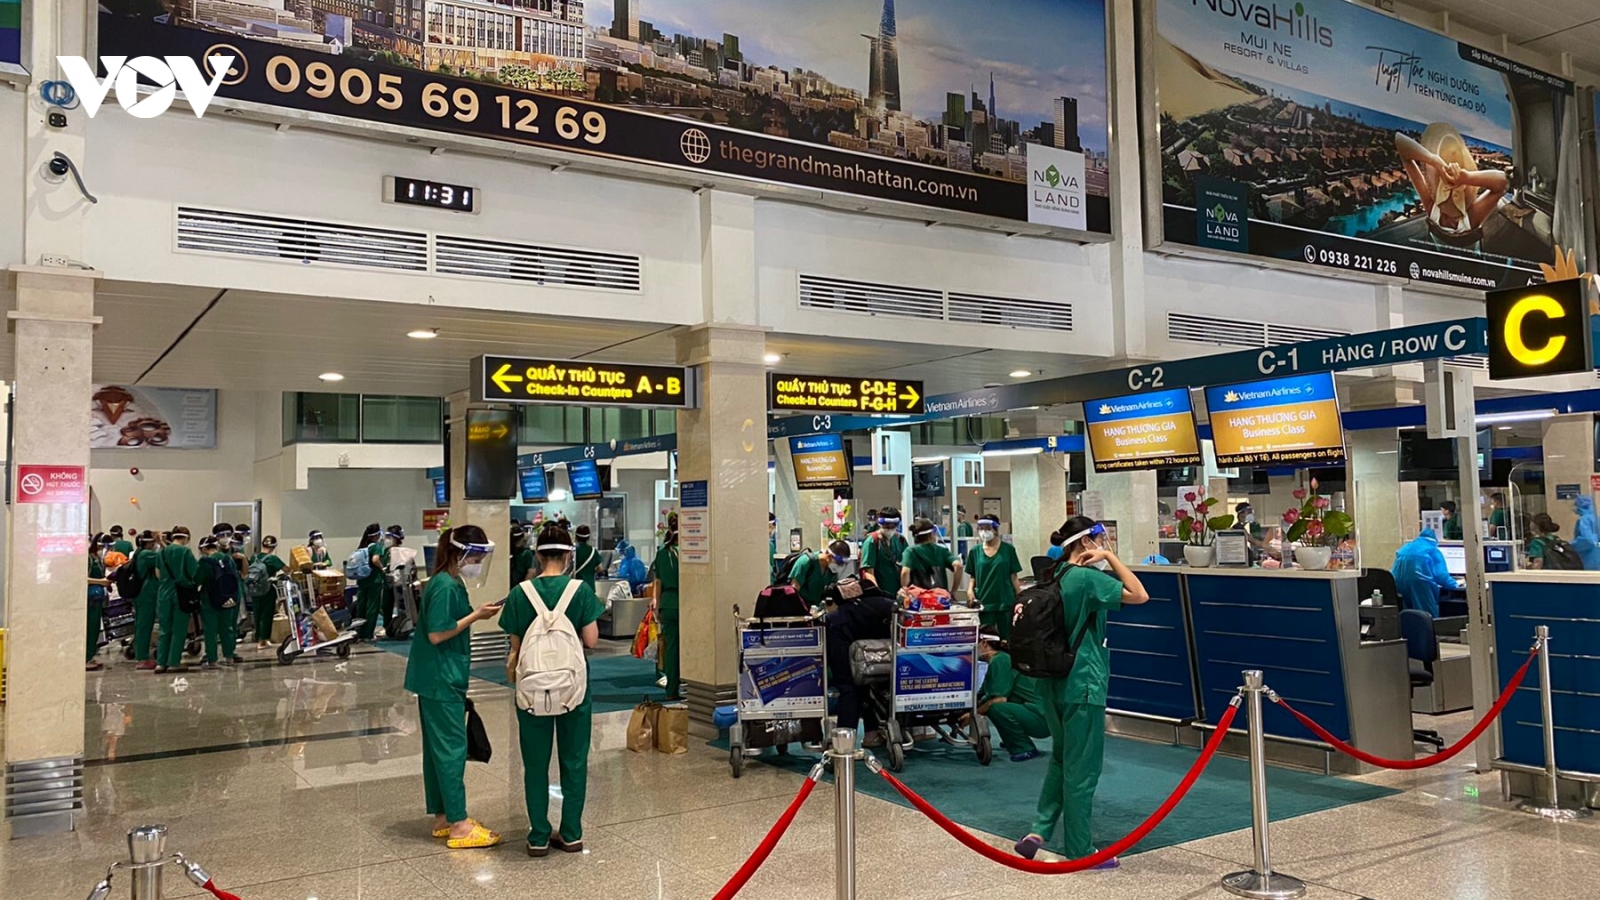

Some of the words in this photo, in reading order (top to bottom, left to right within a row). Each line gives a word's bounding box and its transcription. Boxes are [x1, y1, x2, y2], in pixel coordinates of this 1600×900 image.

[1240, 31, 1268, 50] MUI
[1273, 42, 1292, 58] NE
[1223, 42, 1263, 61] RESORT
[1266, 55, 1275, 64] &
[1277, 59, 1309, 75] VILLAS
[266, 55, 403, 111] 0905
[421, 82, 480, 123] 69
[495, 95, 540, 134] 12
[555, 107, 607, 145] 69
[1457, 96, 1474, 110] CAO
[719, 139, 979, 202] thegrandmanhattan.com.vn
[407, 181, 471, 206] 11:31
[1034, 190, 1080, 208] LAND
[1206, 224, 1239, 238] LAND
[1319, 249, 1350, 267] 0938
[1354, 255, 1373, 270] 221
[1377, 259, 1397, 274] 226
[1422, 268, 1496, 288] novahillsmuine.com.vn
[1504, 294, 1567, 366] C
[1322, 343, 1375, 365] HÀNG
[1391, 334, 1438, 355] ROW
[1444, 325, 1467, 351] C
[1258, 347, 1298, 375] C-1
[1127, 367, 1164, 391] C-2
[526, 382, 580, 396] Check-in
[581, 385, 633, 399] Counters
[861, 381, 897, 396] C-D-E
[776, 394, 817, 406] Check-in
[818, 396, 858, 408] Counters
[861, 396, 897, 411] F-G-H
[812, 414, 832, 431] C-3
[1299, 409, 1317, 420] GIA
[1161, 421, 1177, 431] GIA
[1242, 426, 1281, 438] Business
[1282, 424, 1306, 434] Class
[1115, 436, 1147, 447] Business
[1147, 434, 1168, 443] Class
[584, 446, 595, 458] C-5
[1272, 452, 1280, 460] All
[1281, 450, 1317, 461] passengers
[1327, 448, 1343, 458] flight
[1108, 460, 1134, 468] certificates
[1135, 459, 1149, 467] taken
[1149, 458, 1165, 466] within
[1173, 456, 1189, 464] hours
[50, 471, 77, 480] KHÔNG
